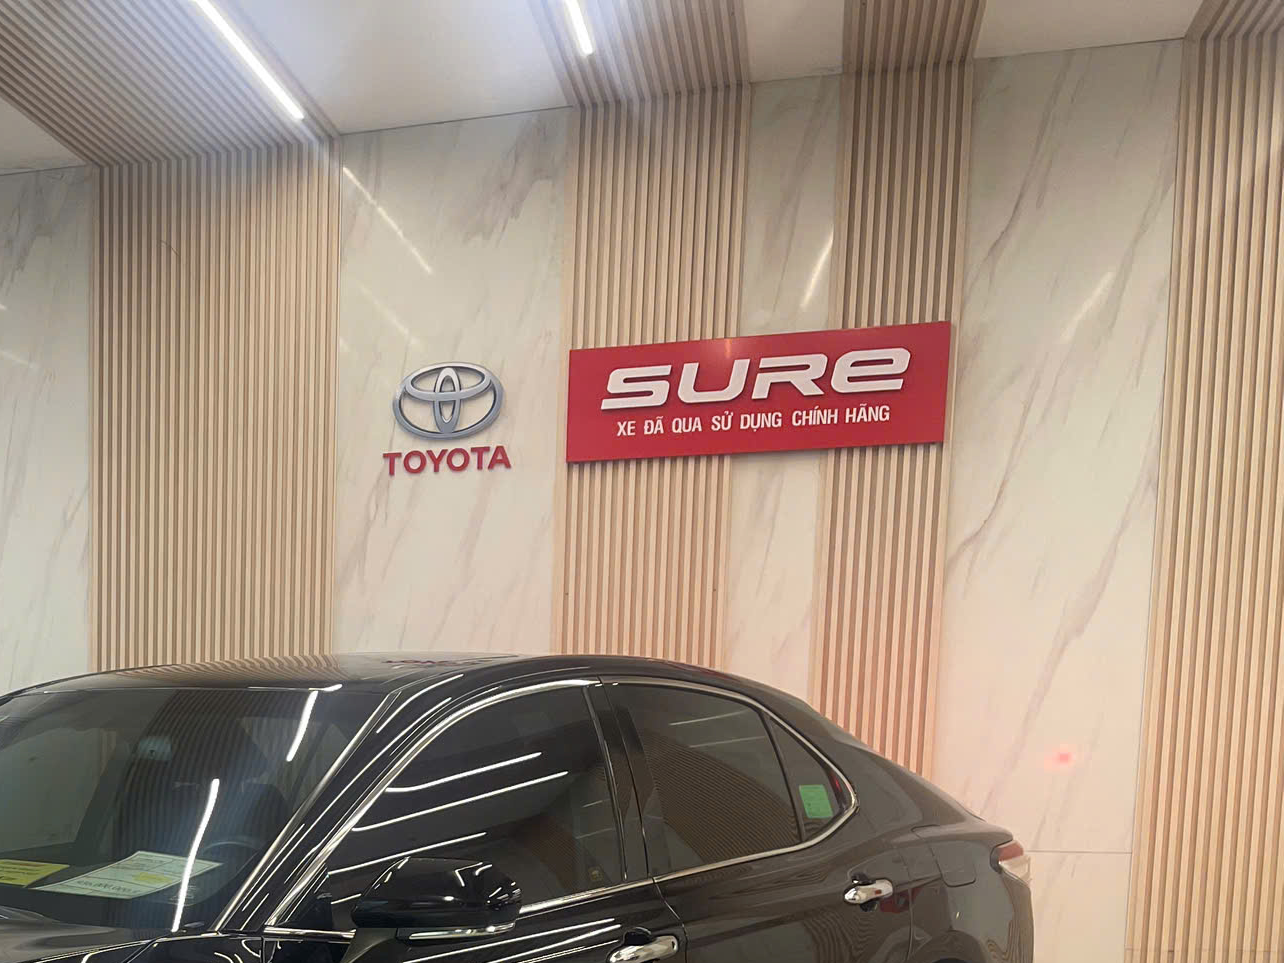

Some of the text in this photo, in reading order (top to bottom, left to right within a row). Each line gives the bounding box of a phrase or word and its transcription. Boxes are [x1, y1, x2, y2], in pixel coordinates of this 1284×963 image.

[616, 403, 891, 437] XE ĐÃ QUA SỬ DỤNG CHÍNH HÃNG
[382, 445, 512, 476] TOYOTA
